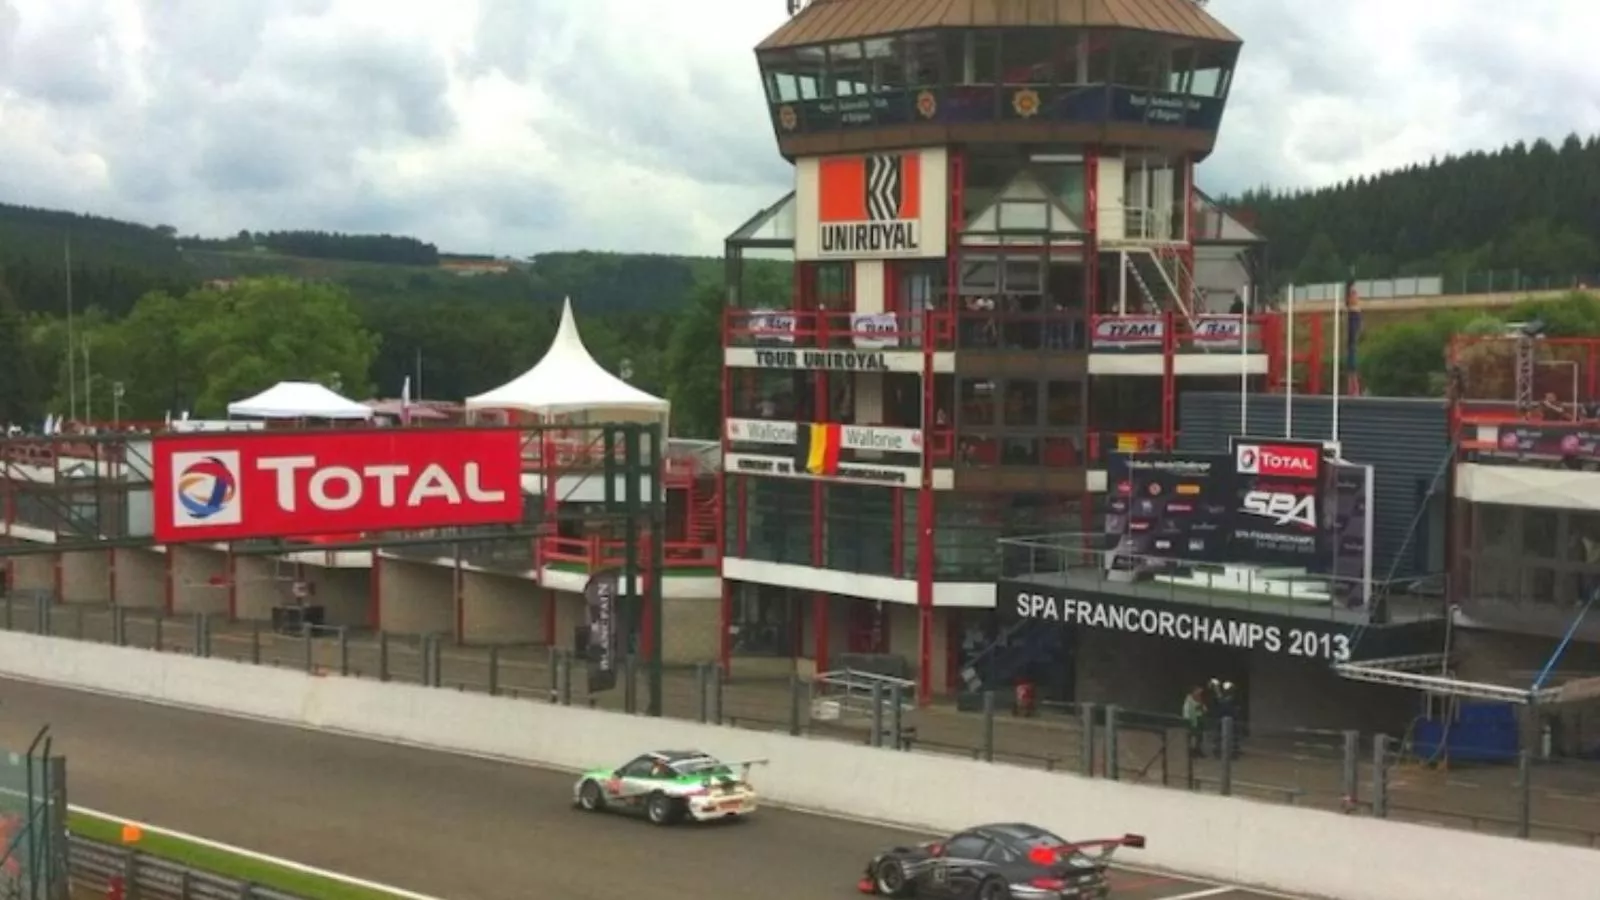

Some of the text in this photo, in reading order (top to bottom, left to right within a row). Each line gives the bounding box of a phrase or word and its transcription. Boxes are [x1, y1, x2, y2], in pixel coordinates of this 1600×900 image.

[821, 223, 919, 251] UNIROYAL
[1109, 324, 1156, 337] TEAM
[755, 350, 889, 370] TOUR UNIROYAL
[846, 429, 903, 449] Wallonie
[256, 455, 505, 512] TOTAL
[1243, 490, 1317, 528] SPA
[1016, 593, 1351, 661] SPA FRANCORCHAMPS 2013
